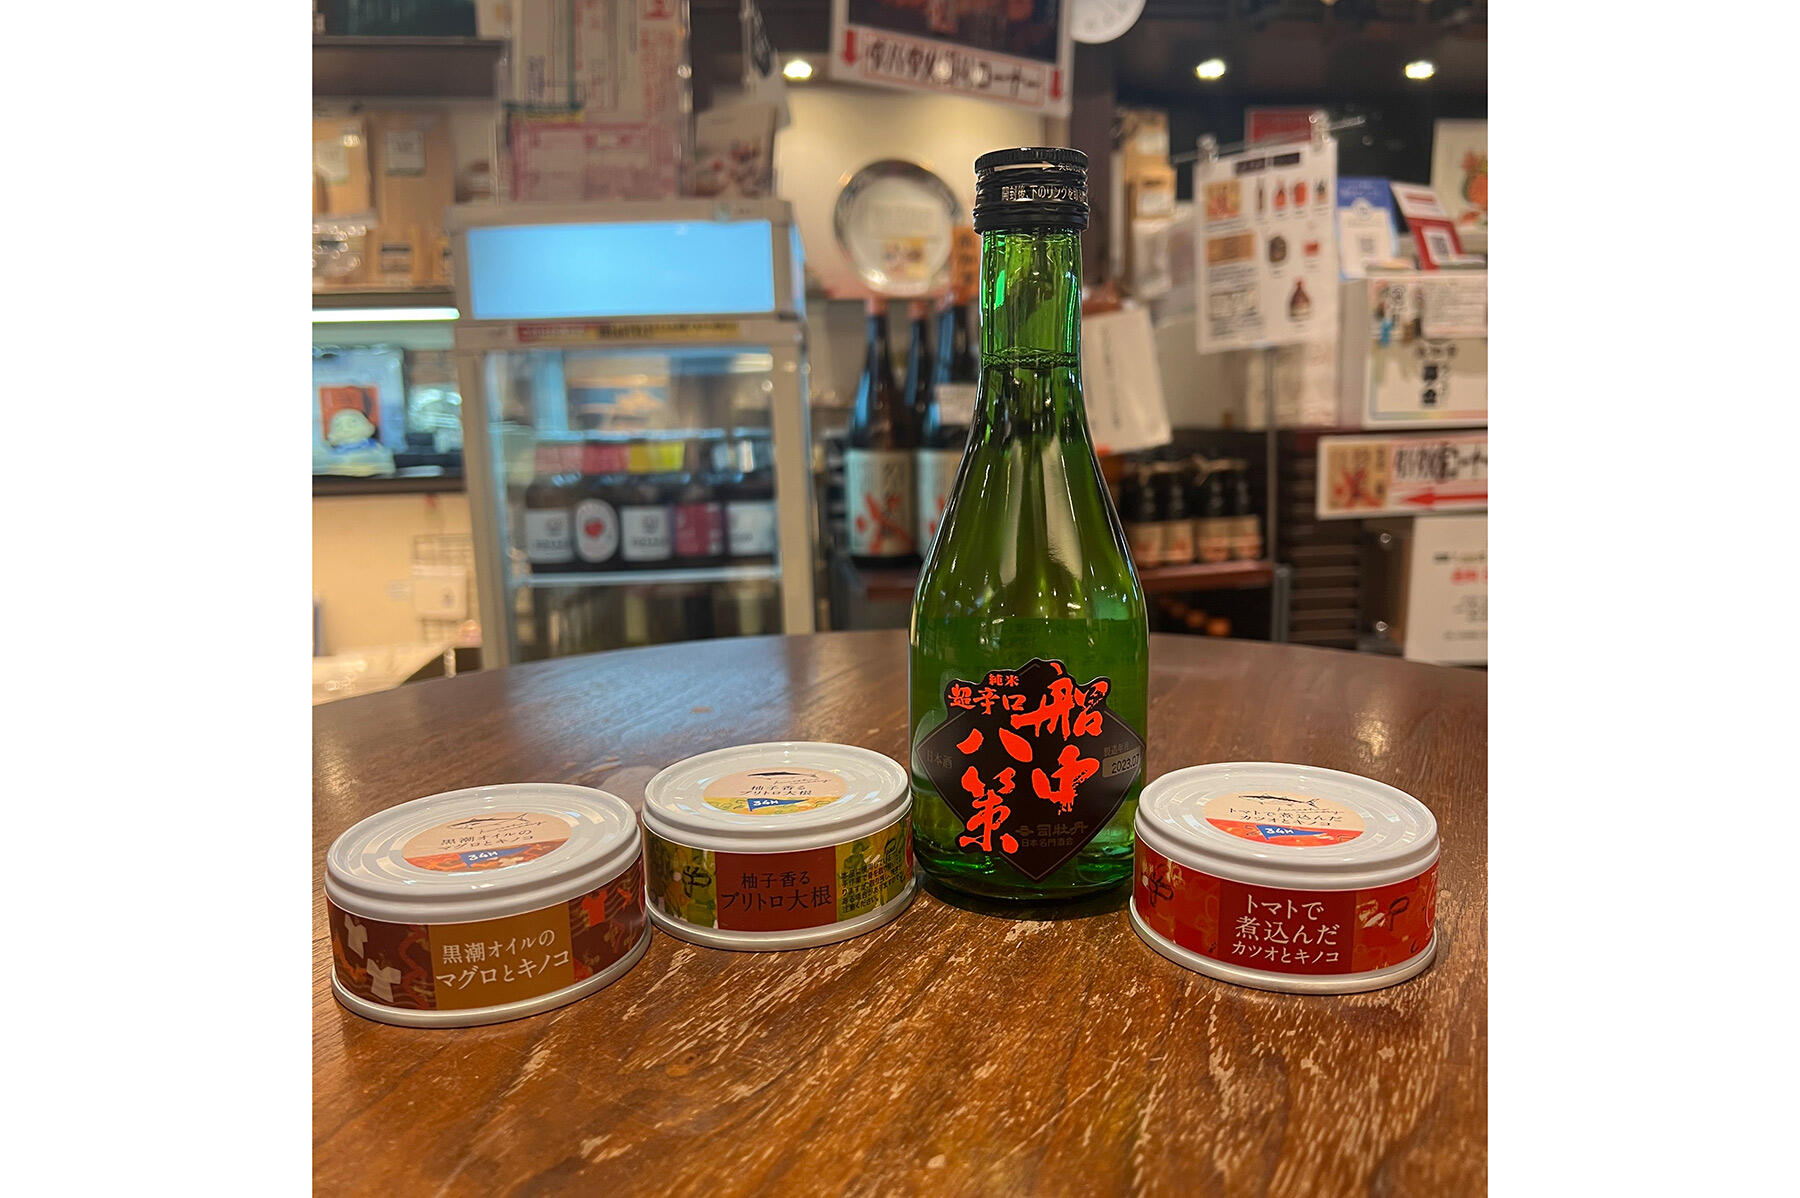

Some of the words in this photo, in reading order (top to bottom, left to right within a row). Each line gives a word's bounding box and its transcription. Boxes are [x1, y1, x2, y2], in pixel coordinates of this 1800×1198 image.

[988, 673, 1020, 687] 純米
[948, 683, 1027, 716] 超辛口
[1111, 753, 1140, 774] 2023.07
[741, 869, 811, 889] 柚子香る
[720, 885, 833, 914] ブリトロ大根
[1245, 893, 1326, 921] トマトで
[1235, 915, 1341, 947] 煮込んだ
[441, 928, 556, 966] 黒潮オイルの
[1231, 939, 1341, 965] カツオとキノコ
[435, 948, 571, 992] マグロとキノコ
